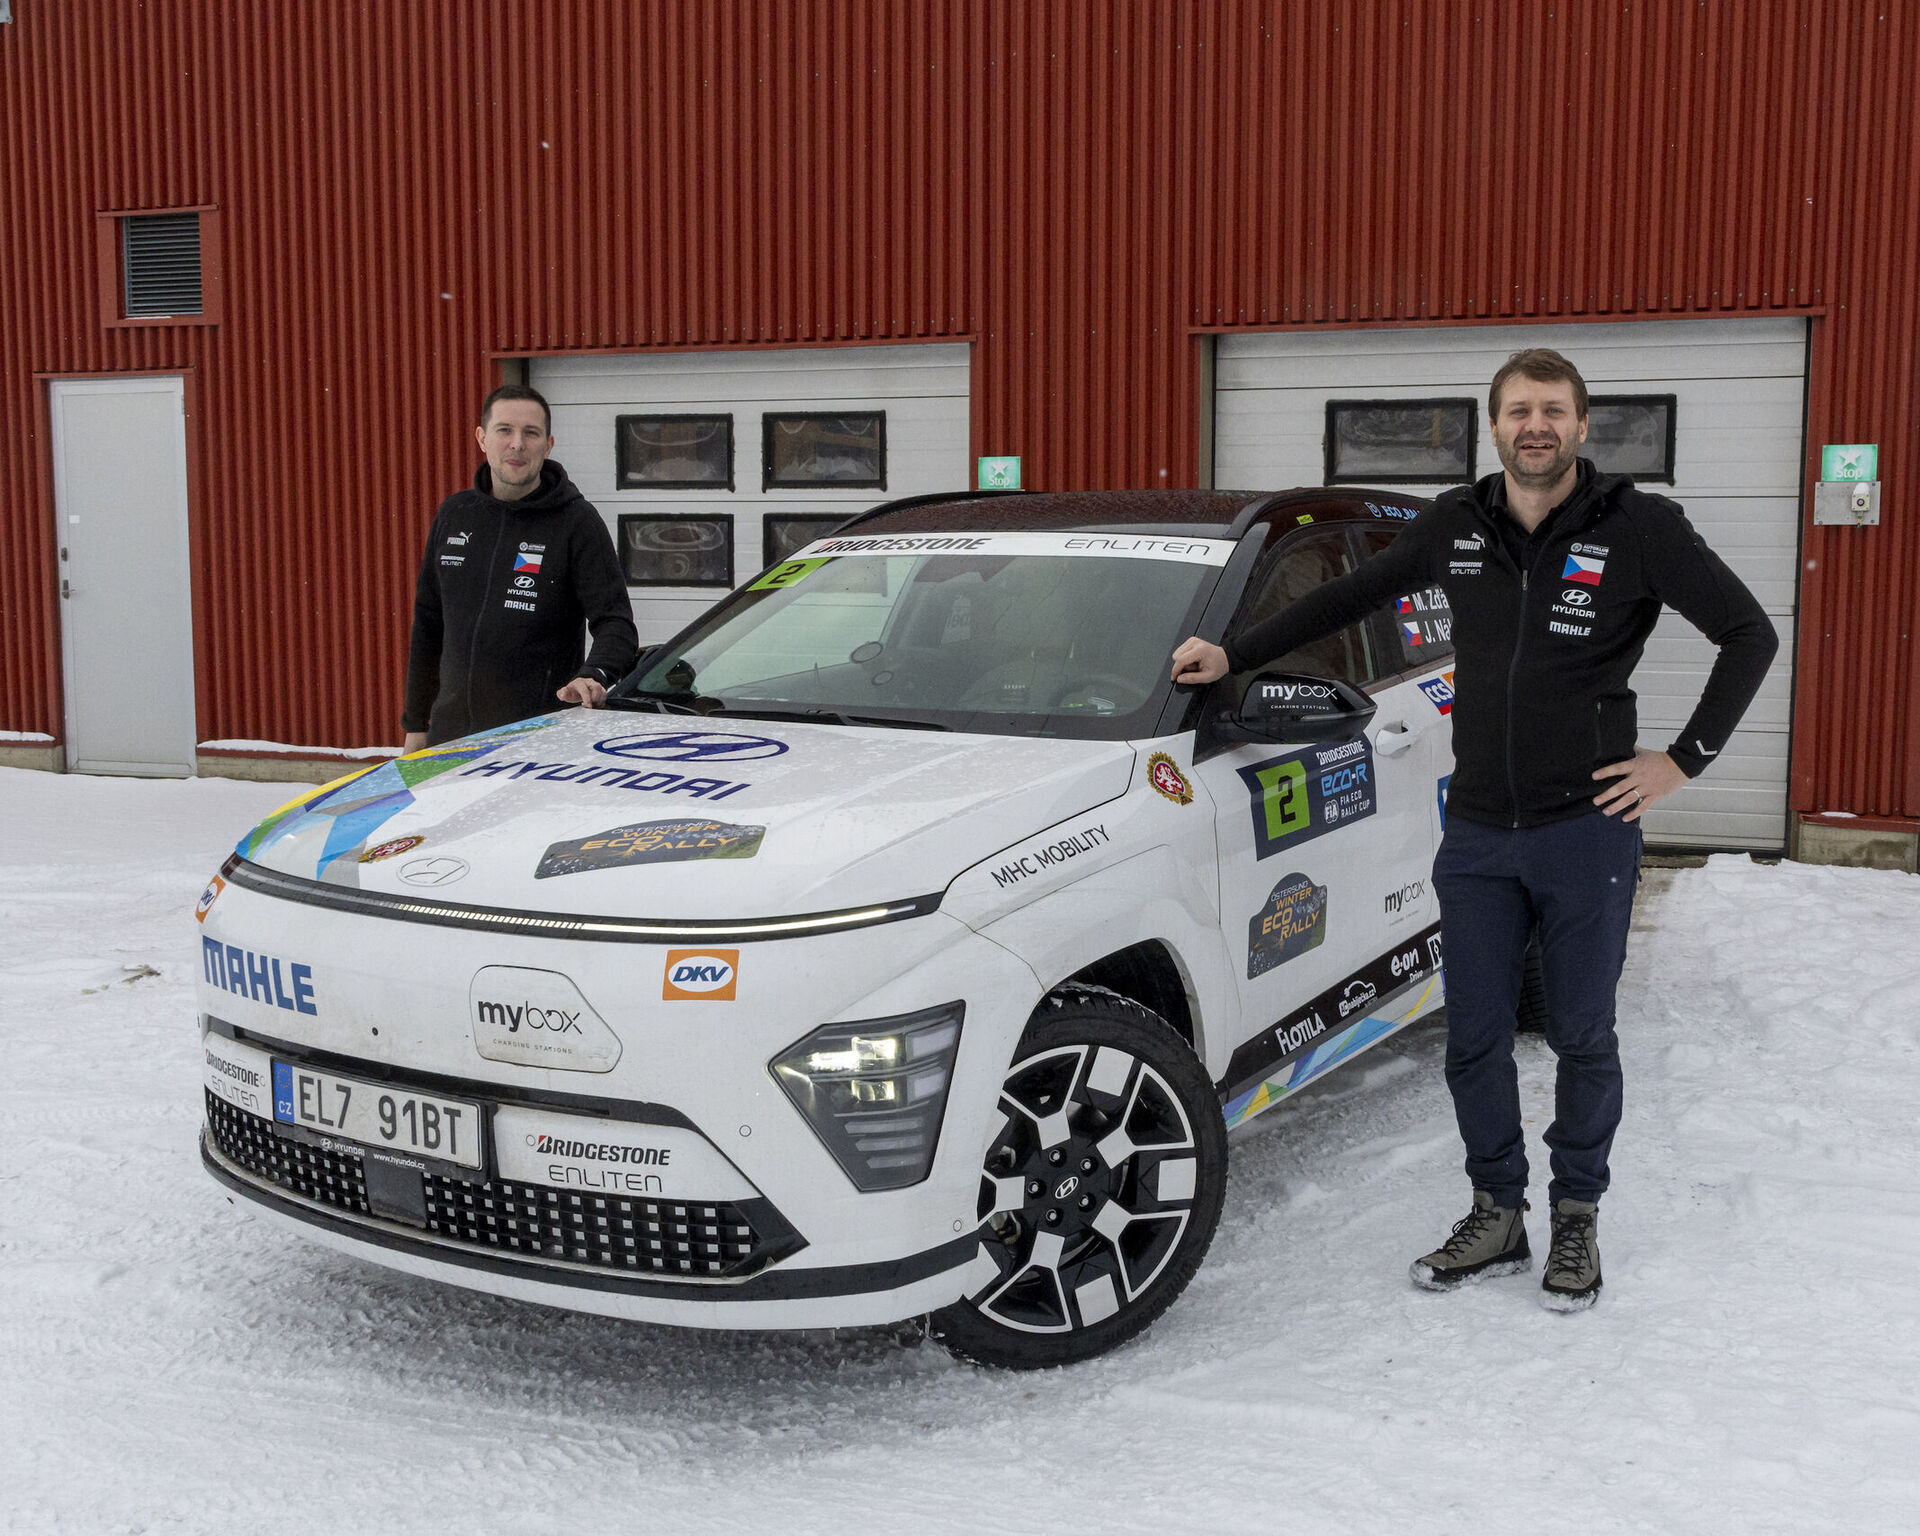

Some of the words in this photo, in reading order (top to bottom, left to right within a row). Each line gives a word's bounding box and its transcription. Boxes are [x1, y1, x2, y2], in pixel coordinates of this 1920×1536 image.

[988, 474, 1010, 488] Stop
[1836, 468, 1863, 480] Stop
[808, 537, 992, 555] BRIDGESTONE
[1064, 537, 1211, 556] ENLITEN
[1454, 539, 1481, 551] PUMA
[773, 563, 806, 584] 2
[507, 588, 538, 598] HYUNDAI
[1412, 592, 1428, 612] M.
[504, 600, 536, 612] MAHLE
[1552, 604, 1596, 618] HYUNDAI
[1424, 620, 1436, 643] J.
[1550, 621, 1591, 636] MAHLE
[1262, 683, 1338, 700] mybox
[1424, 680, 1454, 704] CCS
[1316, 740, 1365, 765] BRIDGESTONE
[459, 761, 751, 800] HYUNDAI
[1277, 775, 1297, 825] 2
[1340, 794, 1350, 806] FIA
[1351, 790, 1362, 802] ECO
[1341, 803, 1358, 818] RALLY
[1359, 799, 1370, 811] CUP
[623, 824, 721, 838] WINTER
[580, 836, 663, 850] ECO
[624, 837, 740, 853] RALLY
[990, 857, 1038, 888] MHC
[1033, 824, 1110, 869] MOBILITY
[1275, 887, 1313, 910] WINTER
[1384, 877, 1426, 913] mybox
[1262, 908, 1293, 935] ECO
[1280, 910, 1320, 940] RALLY
[202, 935, 318, 1016] MAHLE
[672, 966, 729, 982] DKV
[478, 1000, 583, 1034] mybox
[1275, 1012, 1327, 1056] FLOTILA
[492, 1038, 530, 1049] CHARGING
[533, 1044, 573, 1055] STATIONS
[205, 1048, 260, 1088] BRIDGESTONE
[278, 1100, 293, 1116] CZ
[300, 1075, 352, 1129] EL7
[378, 1095, 462, 1155] 91BT
[334, 1142, 366, 1157] HYUNDAI
[537, 1135, 671, 1166] BRIDGESTONE
[373, 1152, 426, 1170] www.hyundai.cz
[548, 1164, 663, 1193] ENLITEN
